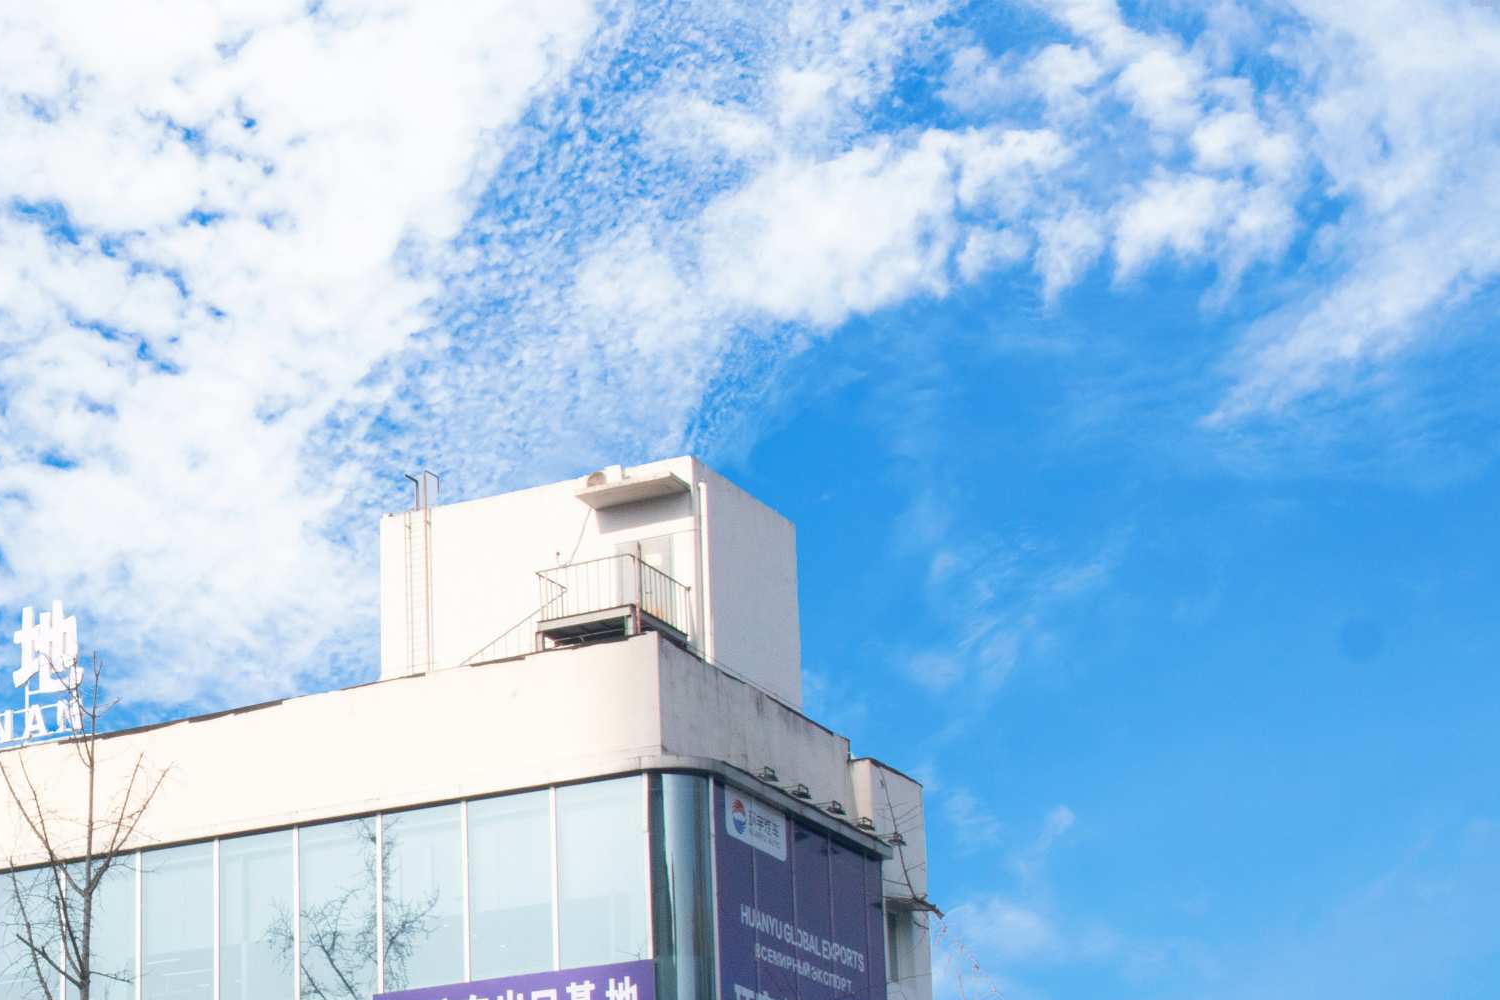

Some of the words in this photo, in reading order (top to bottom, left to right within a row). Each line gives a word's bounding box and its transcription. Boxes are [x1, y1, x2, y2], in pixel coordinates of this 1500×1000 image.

[740, 903, 783, 940] HUANYU
[783, 923, 821, 957] GLOBAL
[821, 939, 865, 972] EXPORTS
